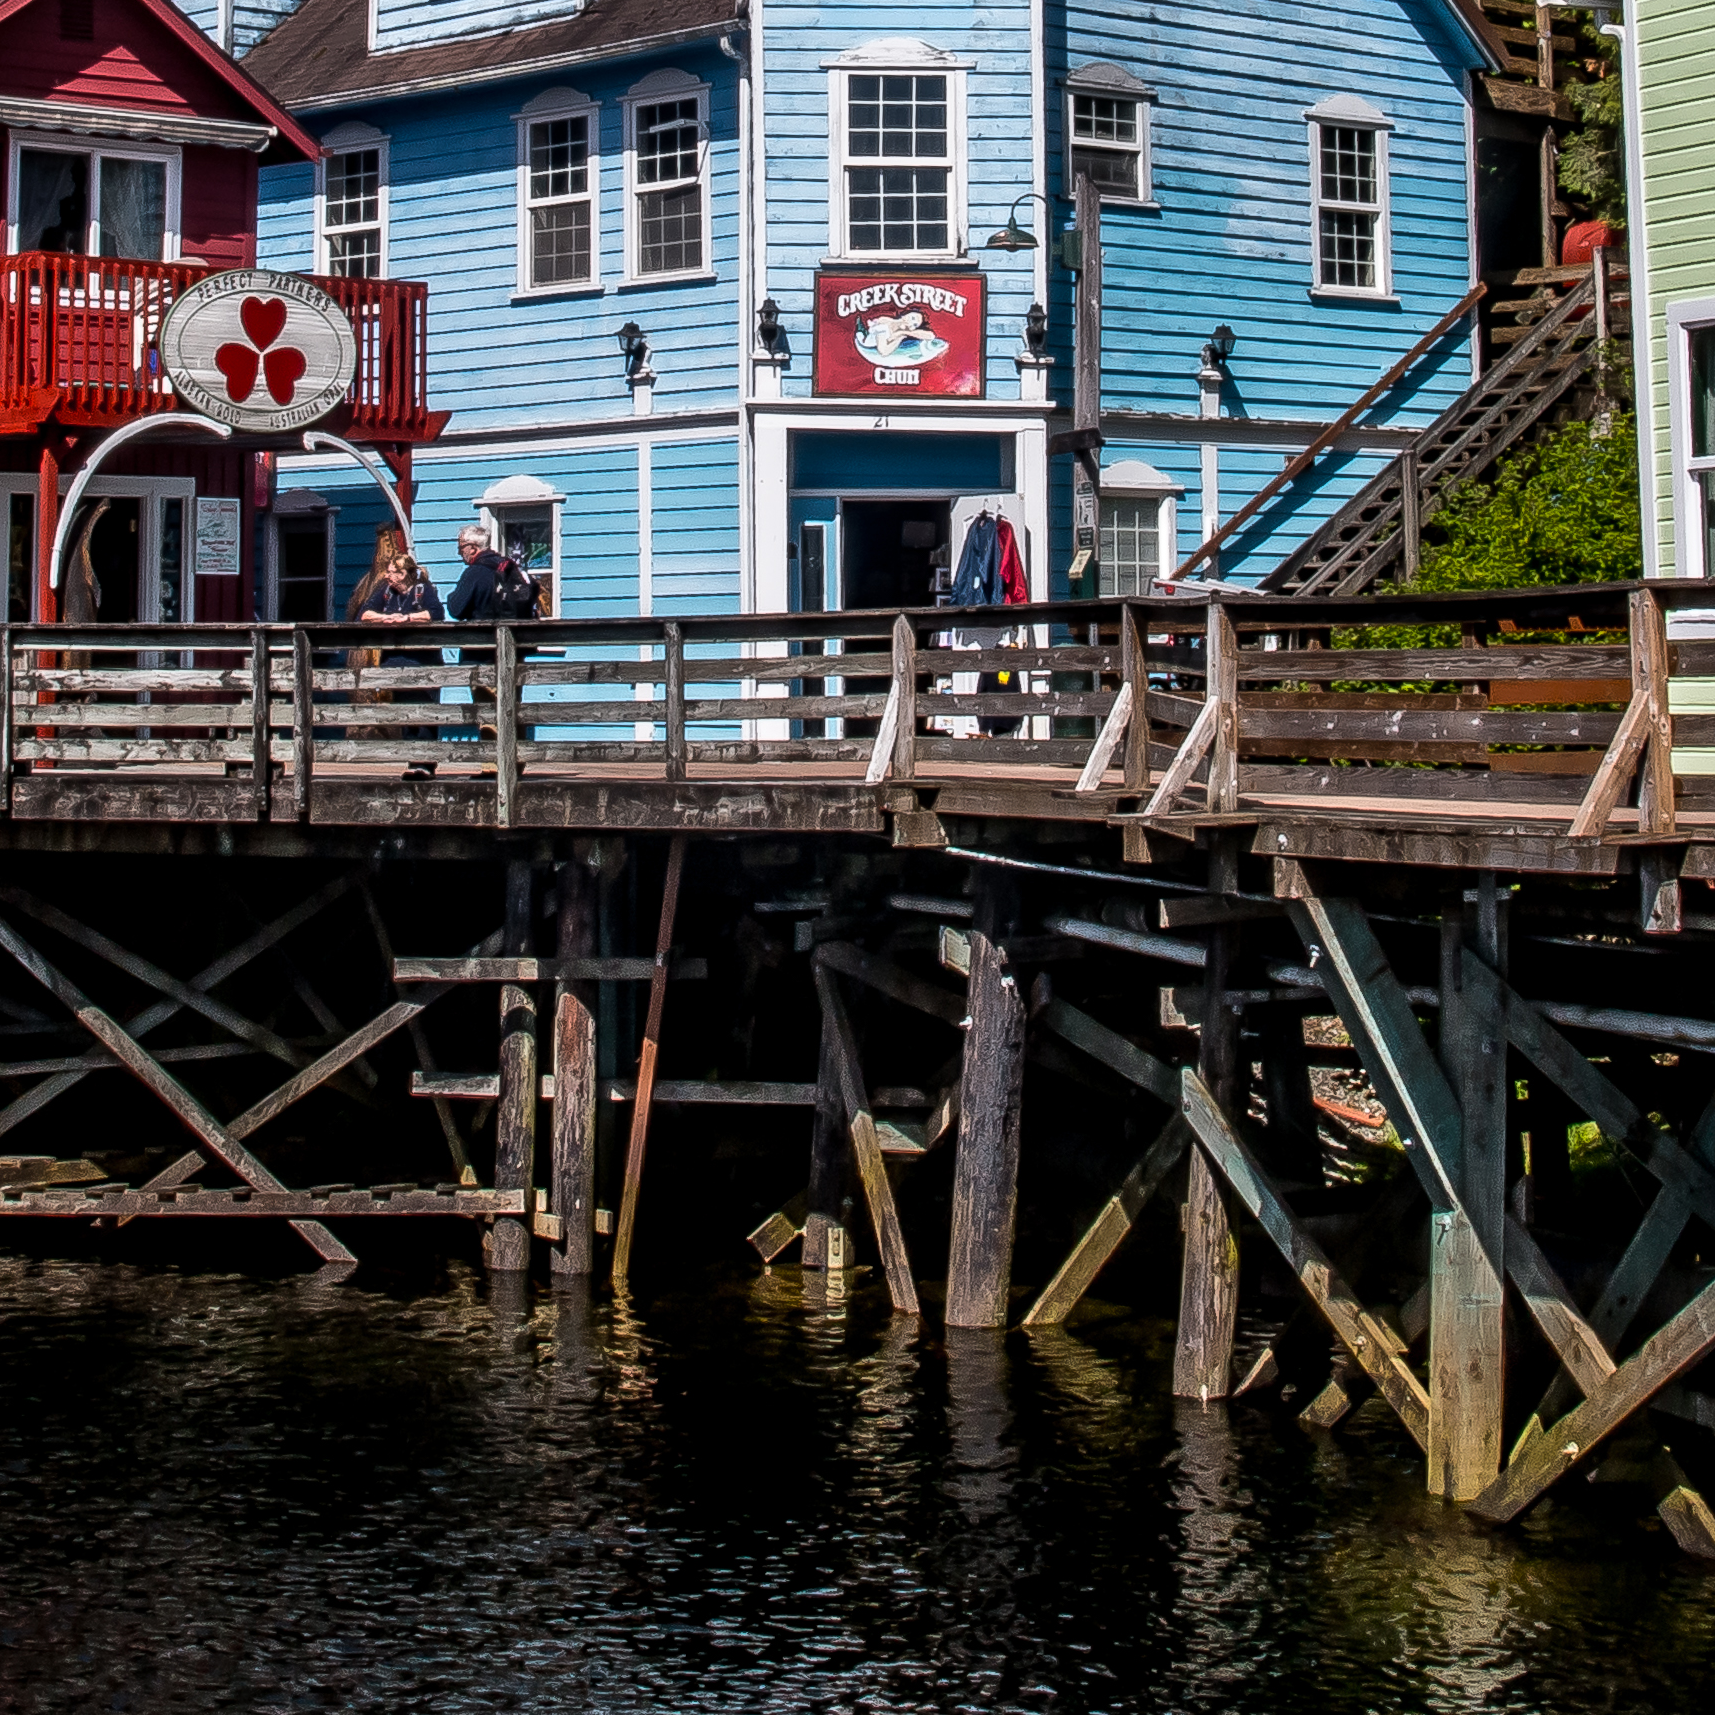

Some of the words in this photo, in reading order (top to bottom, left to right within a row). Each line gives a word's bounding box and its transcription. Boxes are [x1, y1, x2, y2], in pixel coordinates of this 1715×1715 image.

[196, 272, 253, 302] PERFECT
[268, 273, 332, 313] PARTNERS
[837, 282, 908, 317] CREEK
[901, 283, 968, 318] STREET
